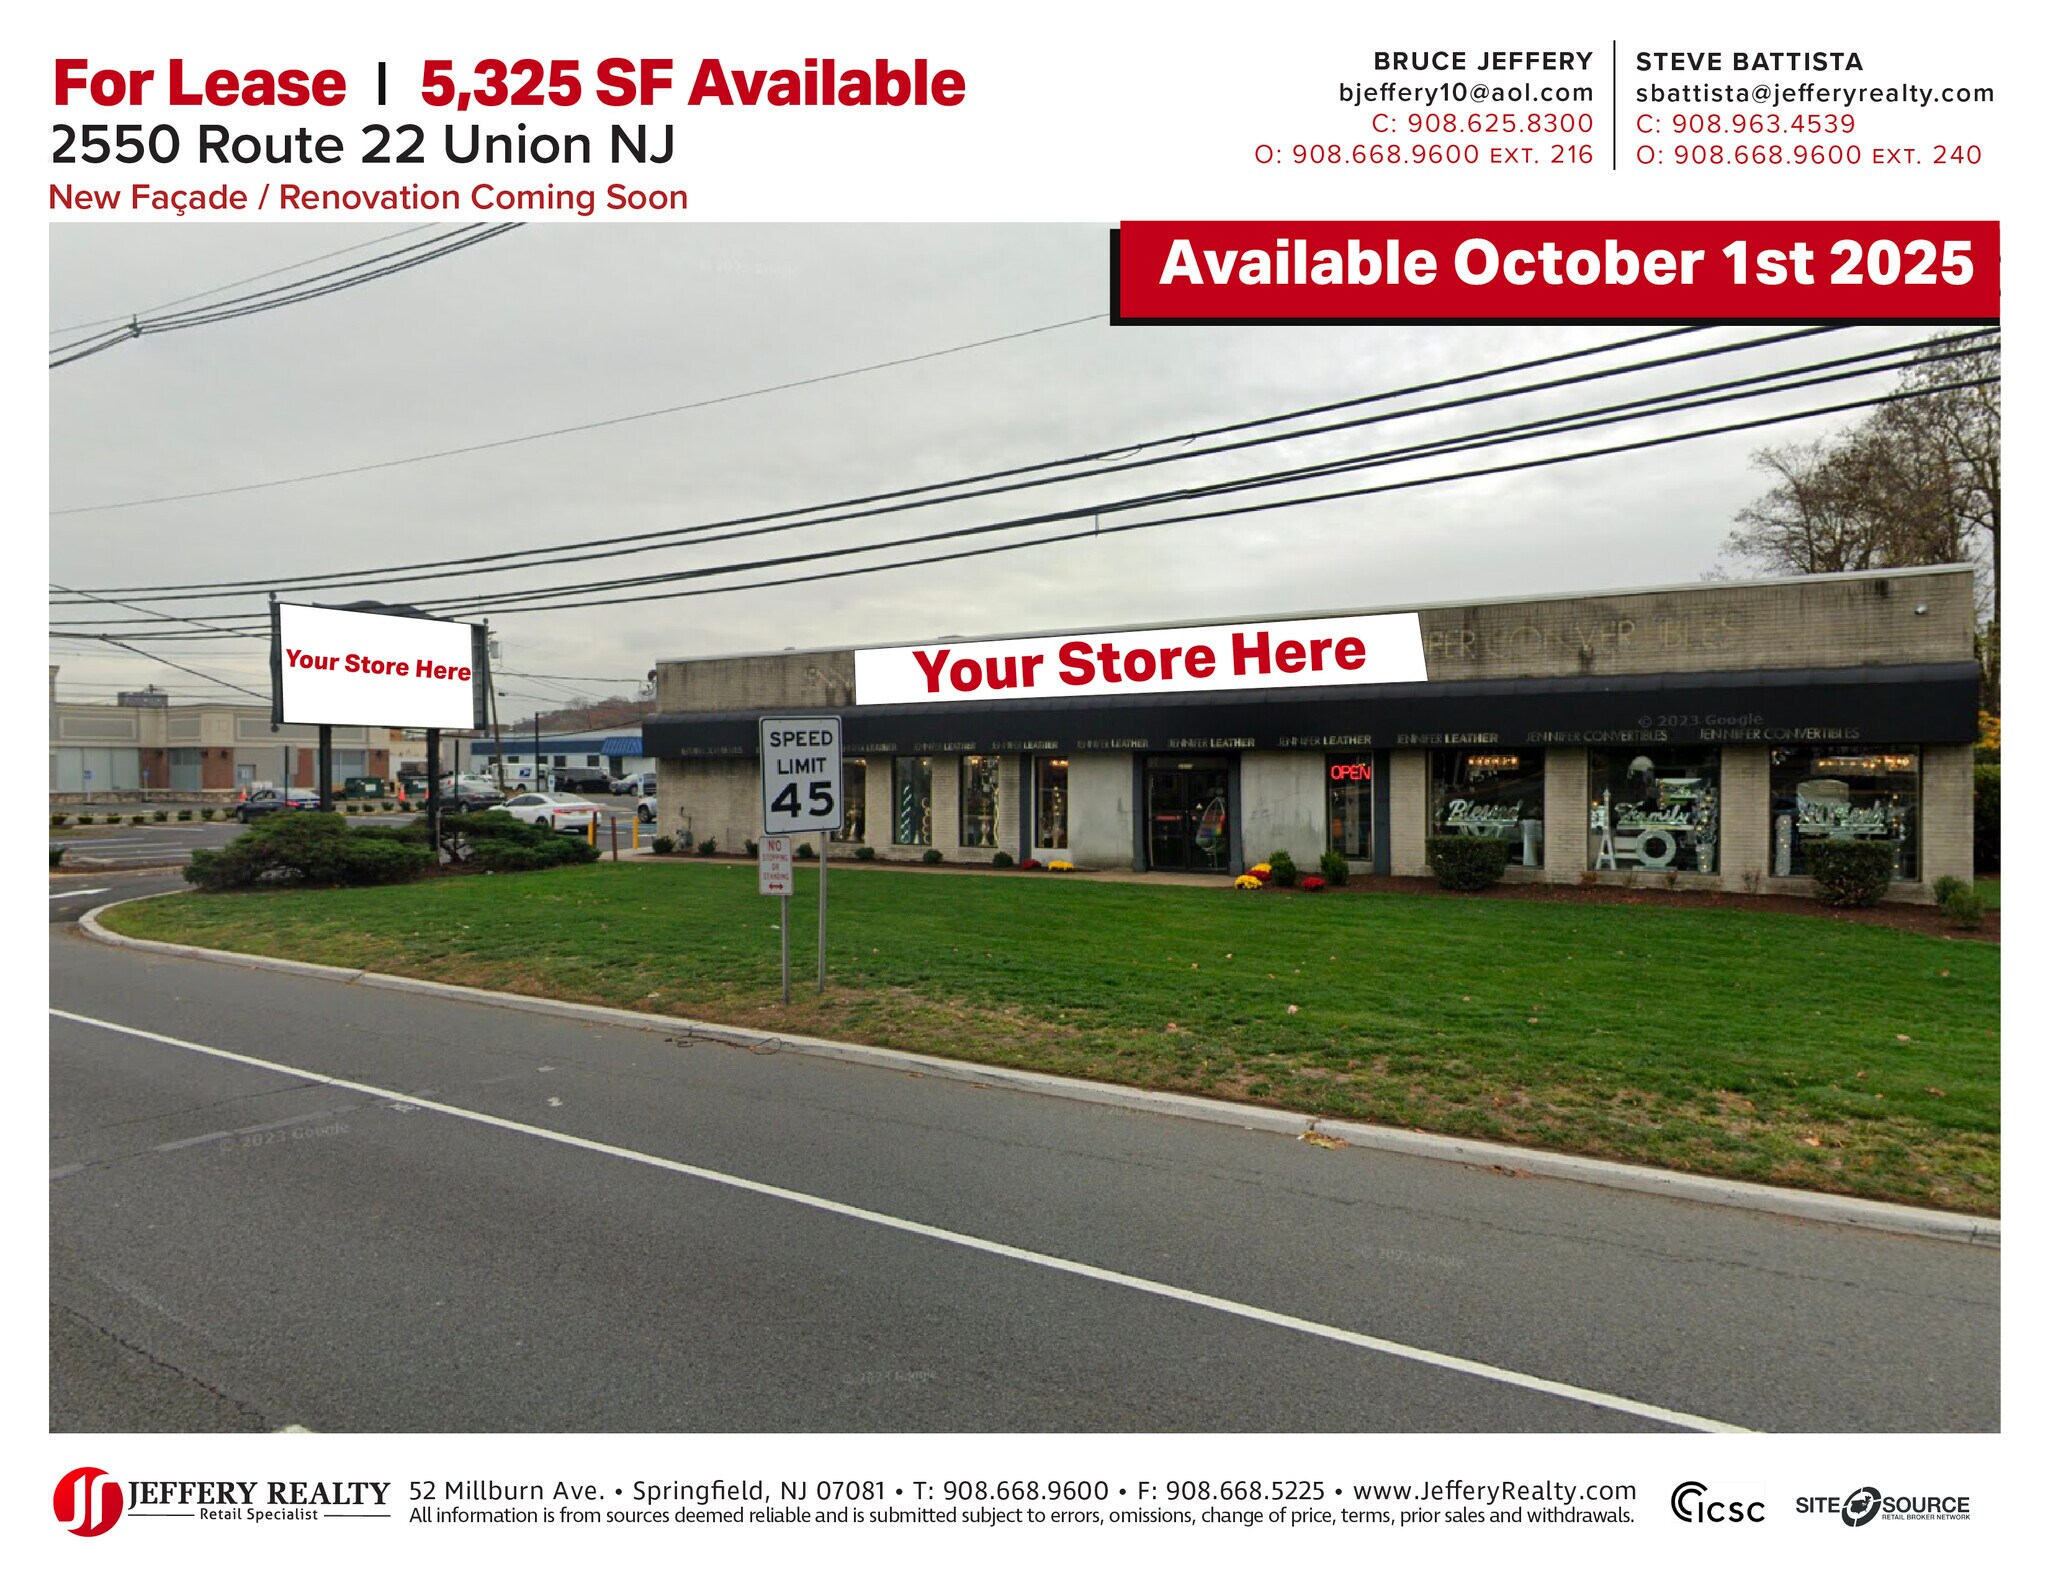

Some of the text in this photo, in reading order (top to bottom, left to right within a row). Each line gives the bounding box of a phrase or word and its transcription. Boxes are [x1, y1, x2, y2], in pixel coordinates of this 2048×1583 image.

[770, 730, 833, 748] SPEED
[1397, 732, 1499, 744] JENNIFER LEATHER
[1526, 729, 1668, 743] JENNIFER CONVERTIBLES
[1700, 727, 1860, 740] JENNIFER CONVERTIBLES
[1111, 738, 1149, 749] LEATHER
[1210, 737, 1256, 748] LEATHER
[1323, 735, 1372, 746] LEATHER
[777, 757, 827, 775] LIMIT
[1331, 764, 1372, 780] OPEN
[771, 781, 834, 818] 45
[768, 840, 782, 852] NO
